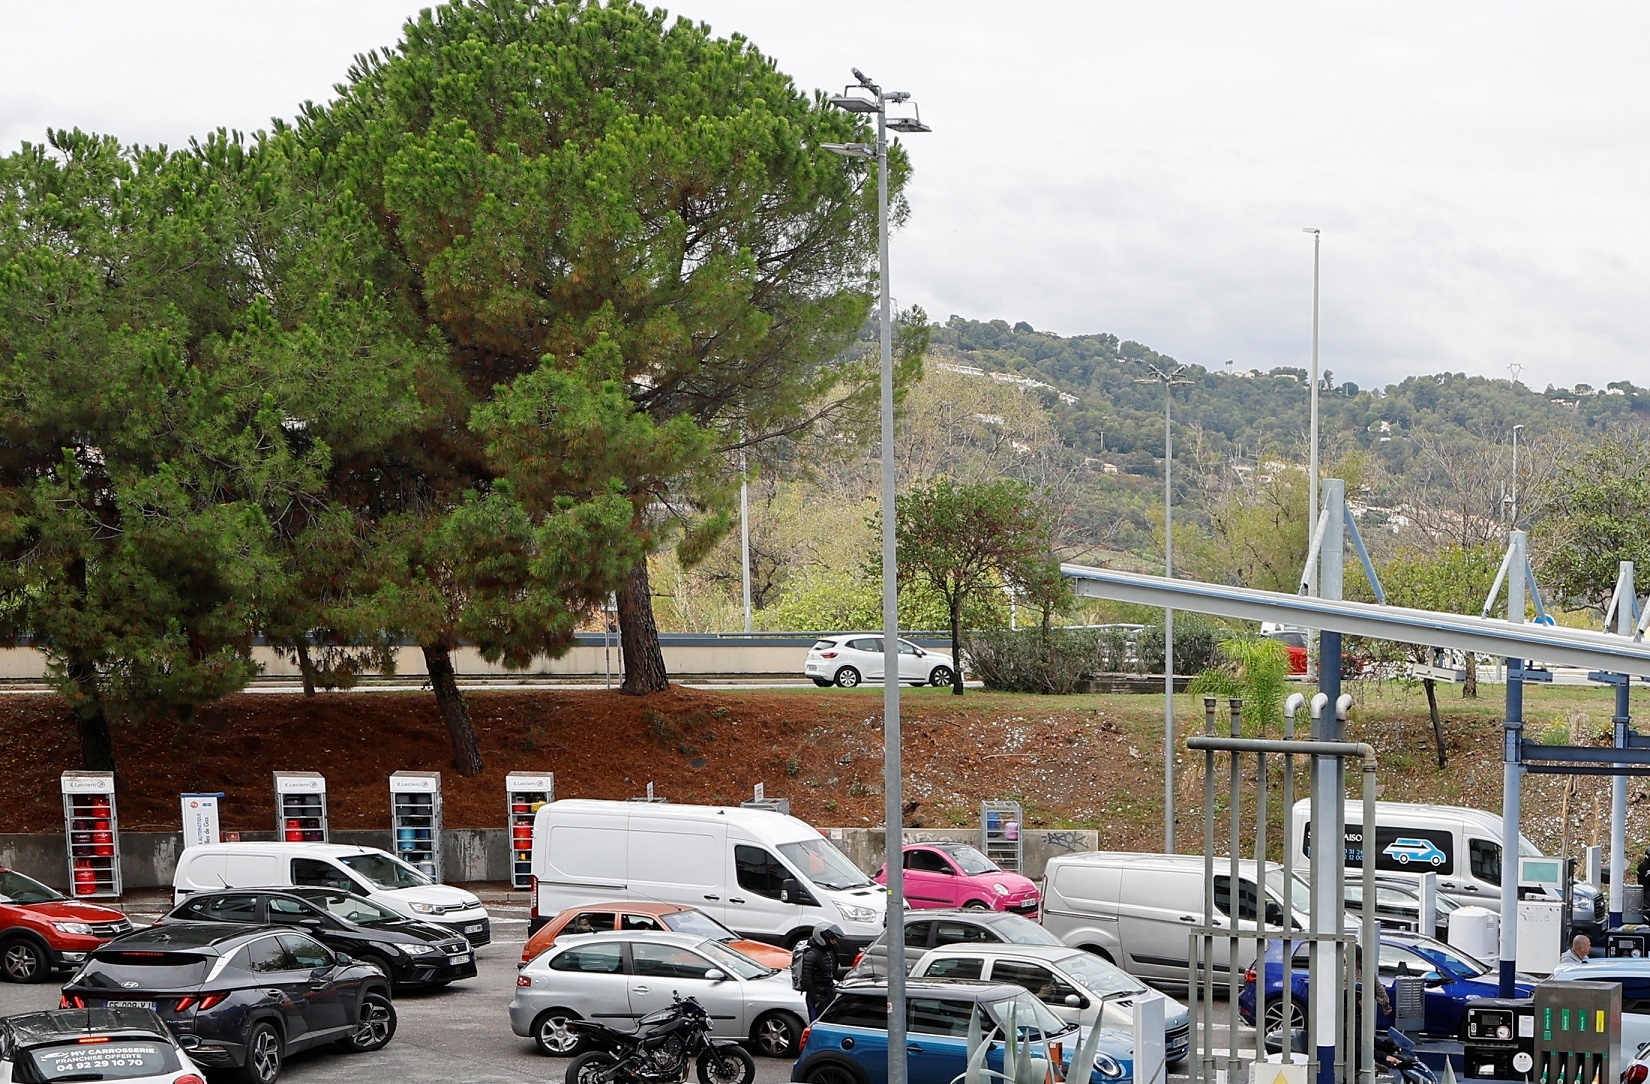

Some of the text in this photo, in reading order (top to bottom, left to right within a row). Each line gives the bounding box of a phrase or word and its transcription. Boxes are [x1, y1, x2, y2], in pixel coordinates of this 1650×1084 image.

[88, 1047, 155, 1055] CARROSSERIE
[55, 1054, 103, 1065] FRANCHISE
[56, 1063, 74, 1072] 04
